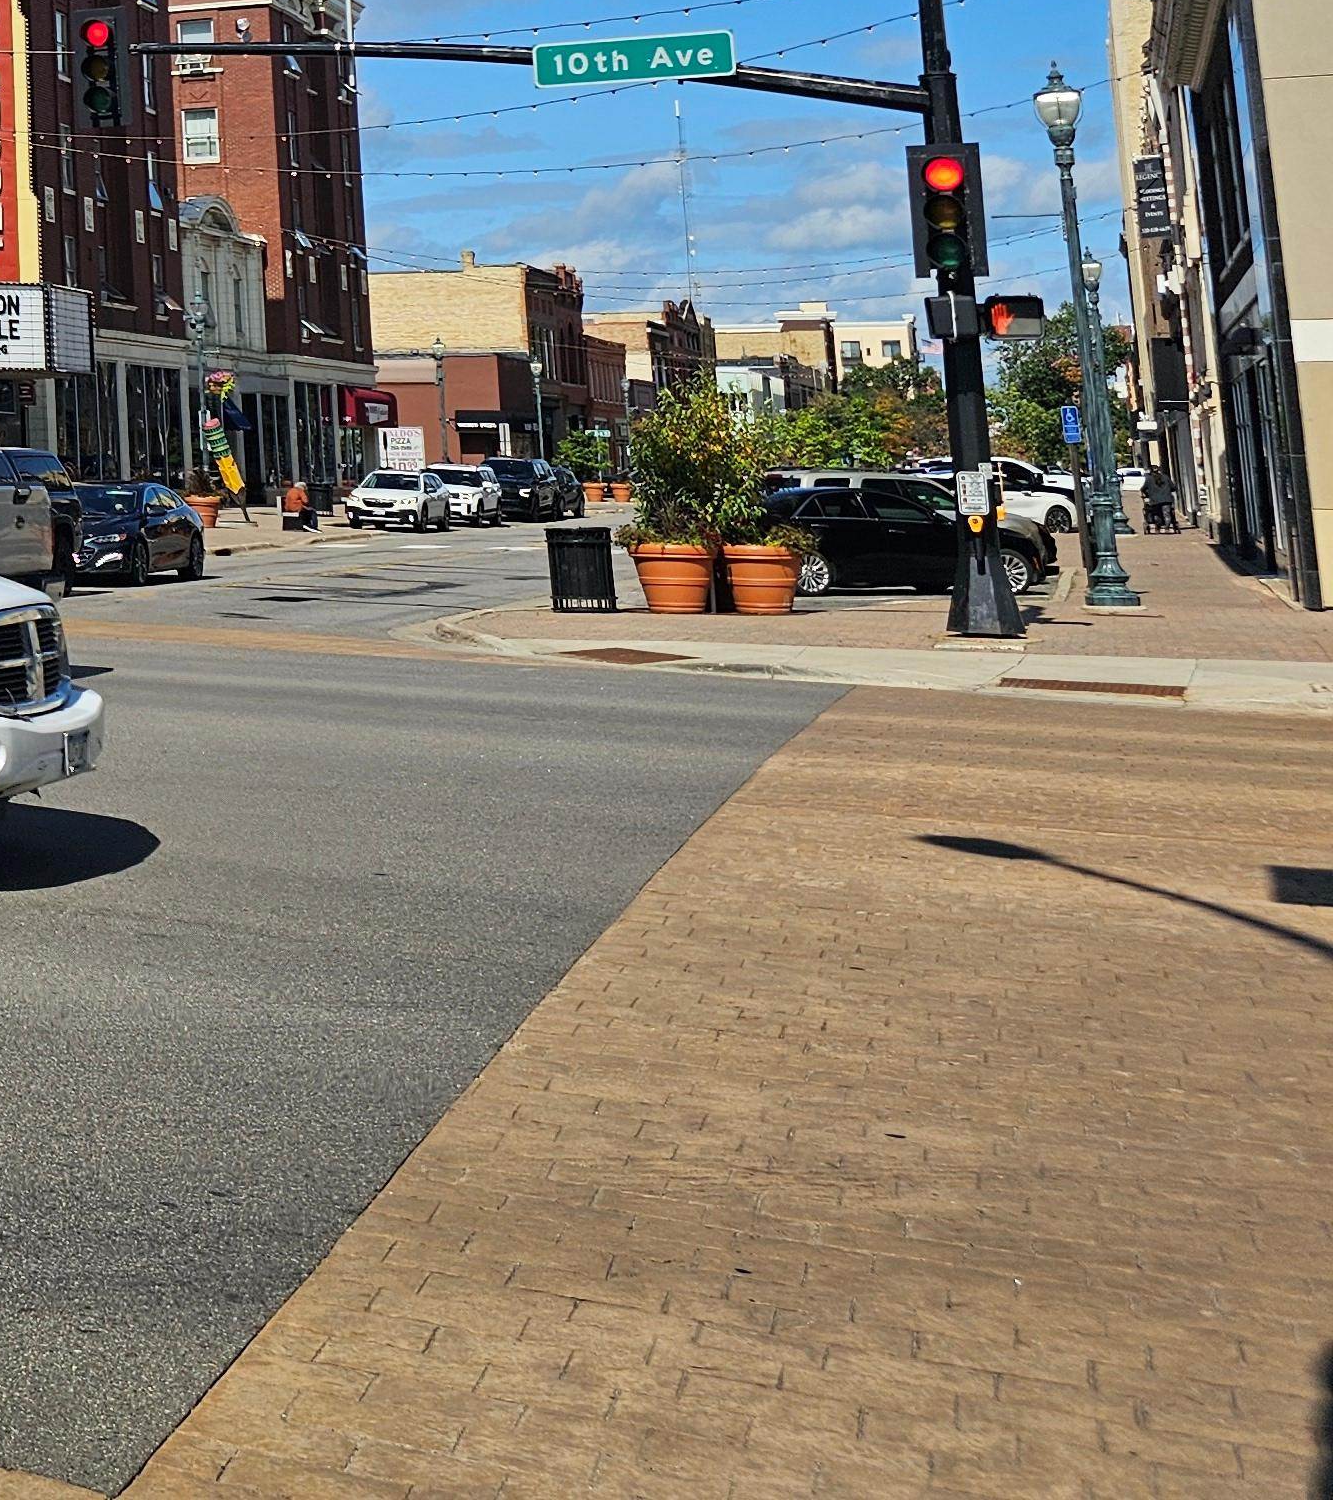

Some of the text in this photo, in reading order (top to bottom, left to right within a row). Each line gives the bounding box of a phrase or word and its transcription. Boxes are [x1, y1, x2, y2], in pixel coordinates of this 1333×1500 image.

[553, 46, 714, 76] 10th Ave
[390, 437, 412, 445] PIZZA
